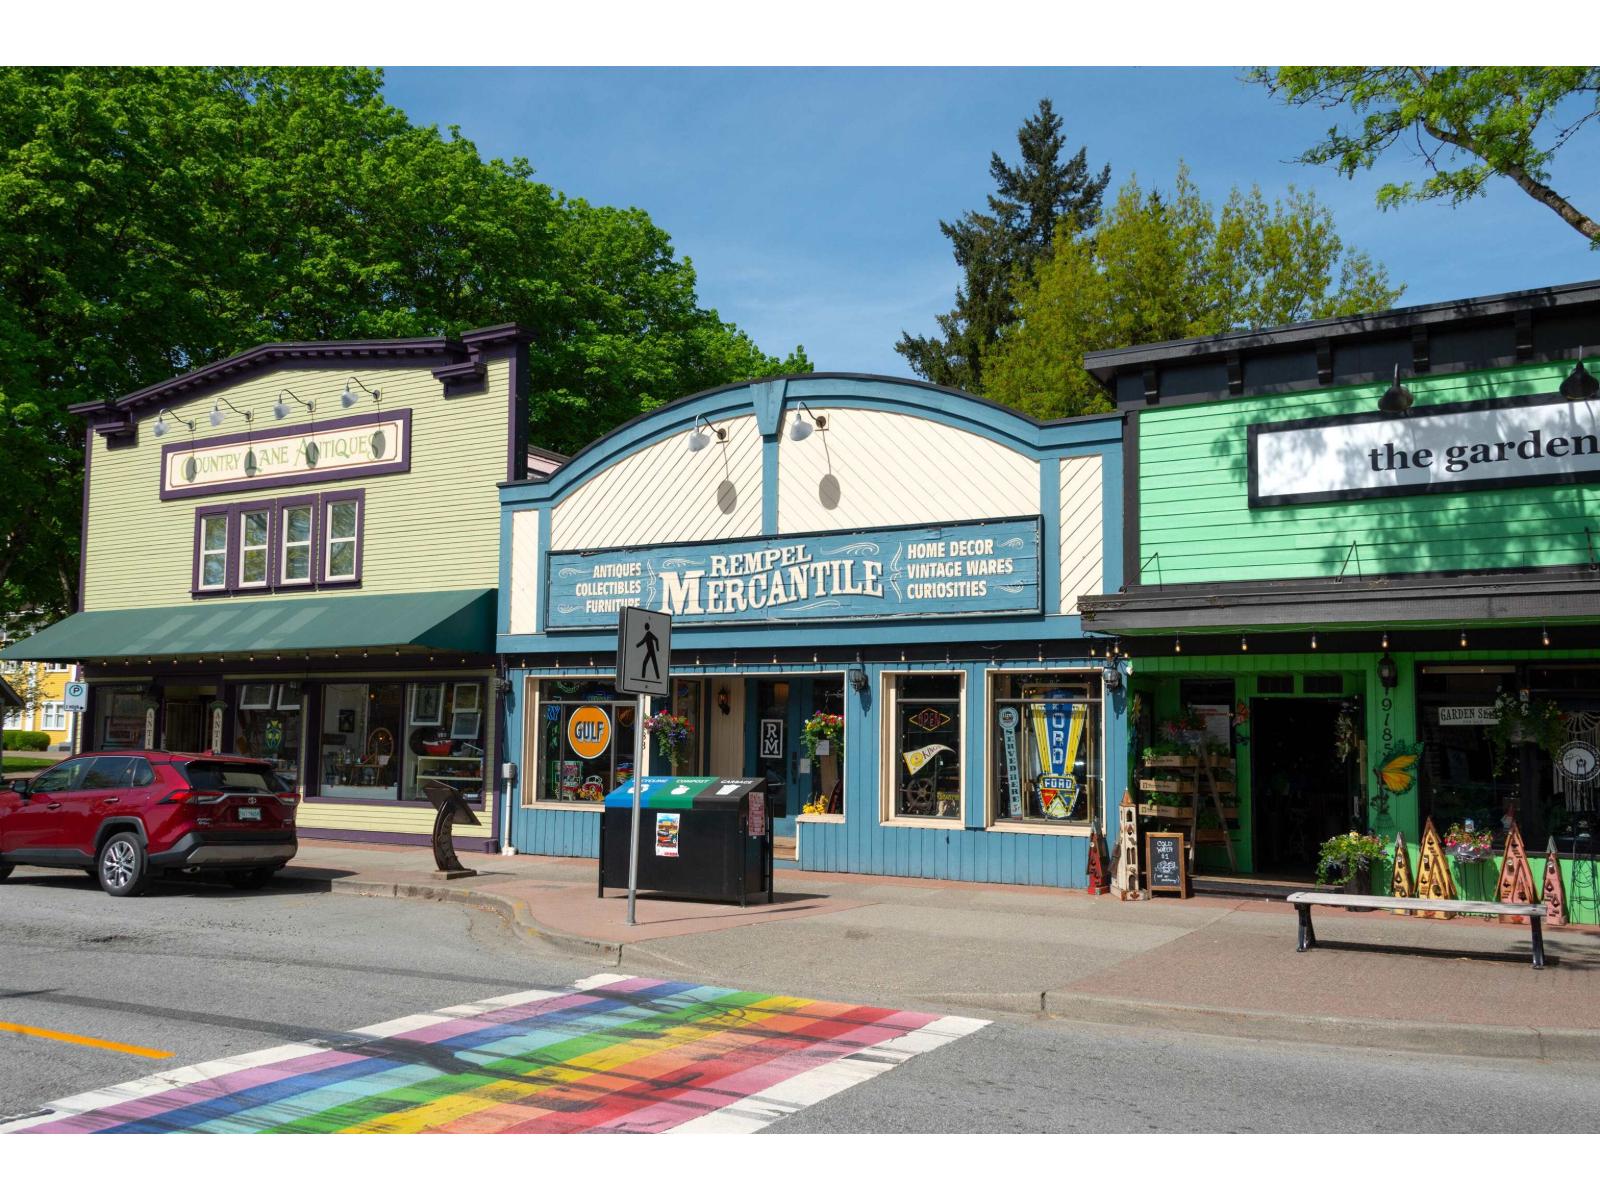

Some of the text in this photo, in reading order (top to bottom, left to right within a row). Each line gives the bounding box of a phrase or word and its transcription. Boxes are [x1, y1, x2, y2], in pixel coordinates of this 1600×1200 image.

[1368, 429, 1600, 473] the garden
[907, 538, 994, 560] HOME DECOR
[592, 562, 642, 579] ANTIQUES
[709, 544, 812, 578] REMPEL
[907, 558, 1014, 580] VINTAGE WARES
[575, 579, 641, 597] COLLECTIBLES
[658, 559, 884, 617] MERCANTILE
[906, 580, 988, 600] CURIOSITIES
[1440, 708, 1475, 721] GARDEN
[575, 720, 605, 744] GULF
[1044, 778, 1073, 790] FORD
